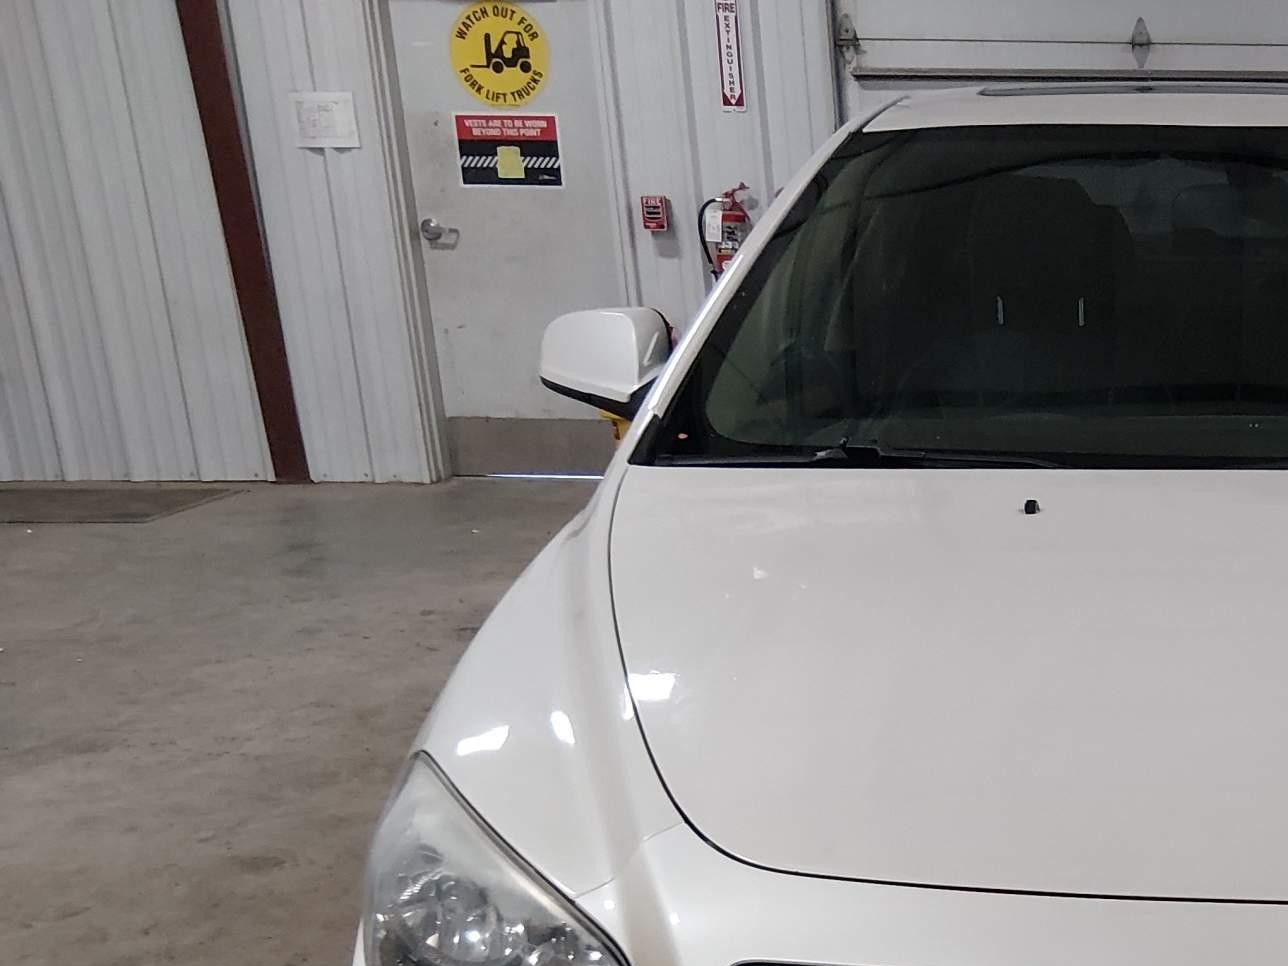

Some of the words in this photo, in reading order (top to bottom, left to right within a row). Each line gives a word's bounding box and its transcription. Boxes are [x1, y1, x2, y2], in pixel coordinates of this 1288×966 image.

[455, 6, 490, 41] WATCH
[492, 5, 517, 21] OUT
[517, 16, 540, 42] FOR
[717, 3, 735, 13] FIRE
[723, 15, 737, 100] EXTINGUISHER
[459, 67, 485, 95] FORK
[485, 89, 508, 103] LIFT
[510, 69, 544, 103] TRUCKS
